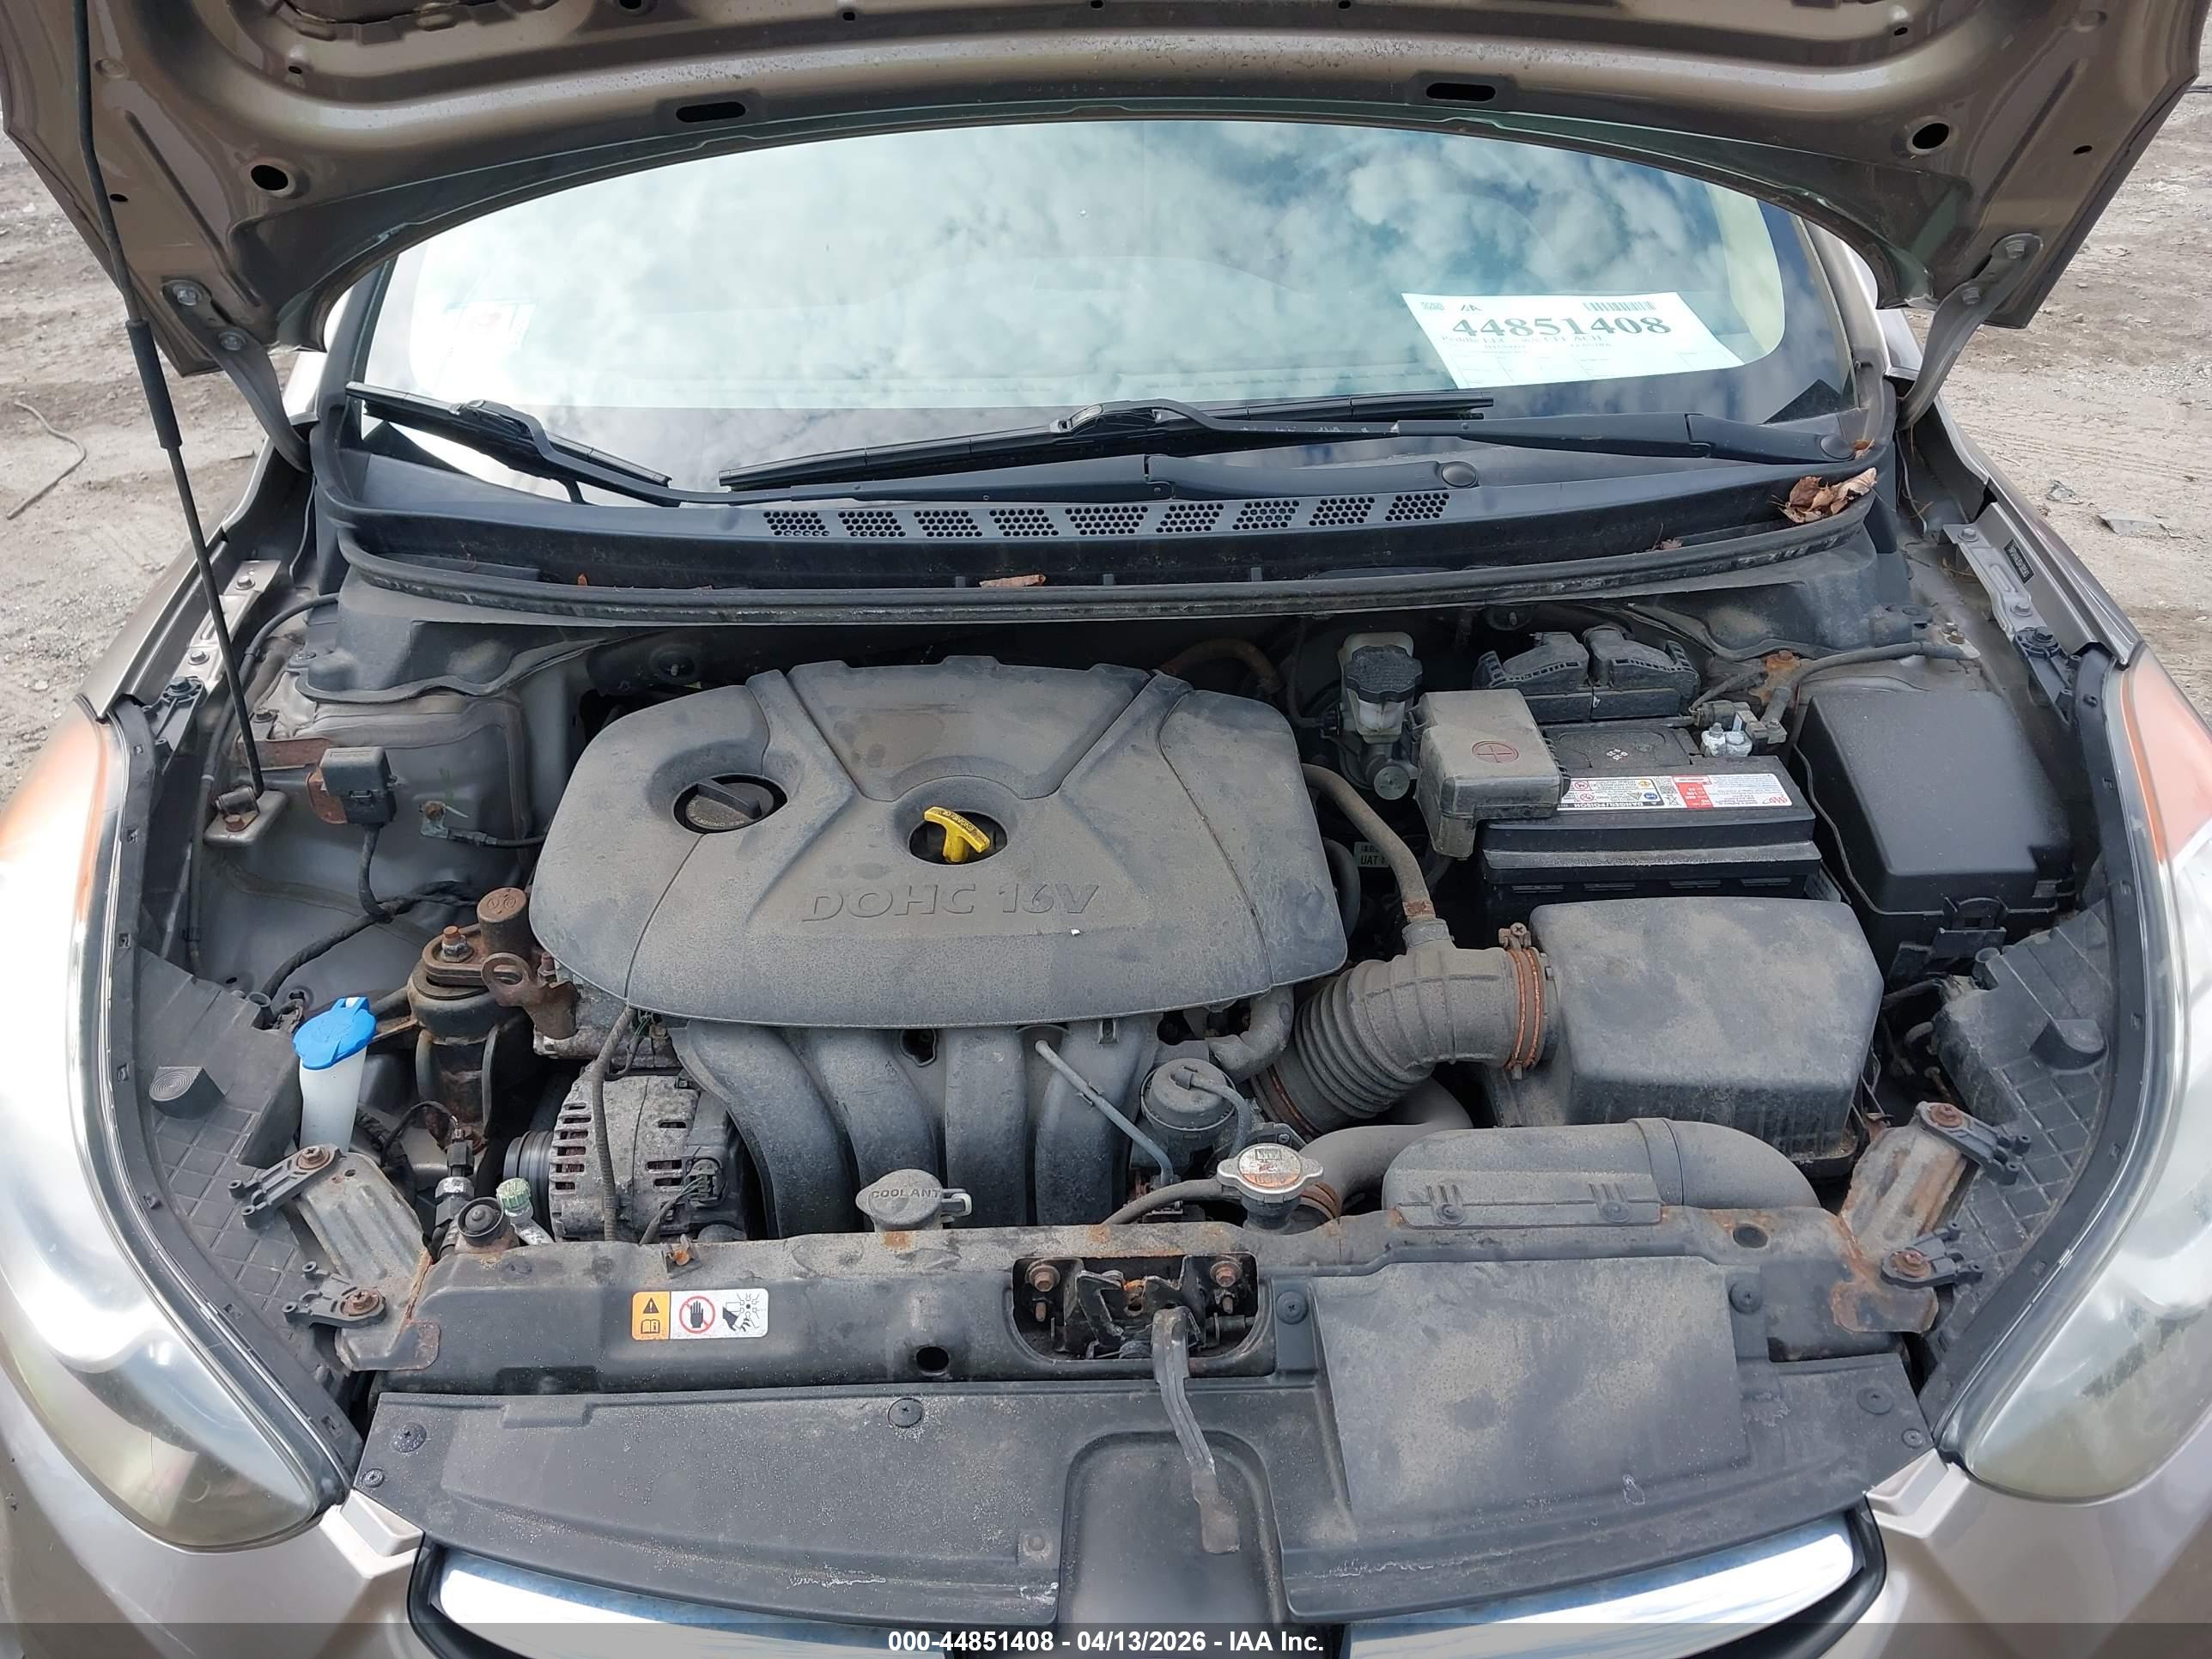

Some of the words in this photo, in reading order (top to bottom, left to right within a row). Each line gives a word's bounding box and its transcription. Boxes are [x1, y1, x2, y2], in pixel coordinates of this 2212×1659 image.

[1452, 317, 1672, 336] 44851408
[801, 884, 976, 922] DOHC
[997, 883, 1100, 915] 16V
[871, 1188, 941, 1199] COOLANT
